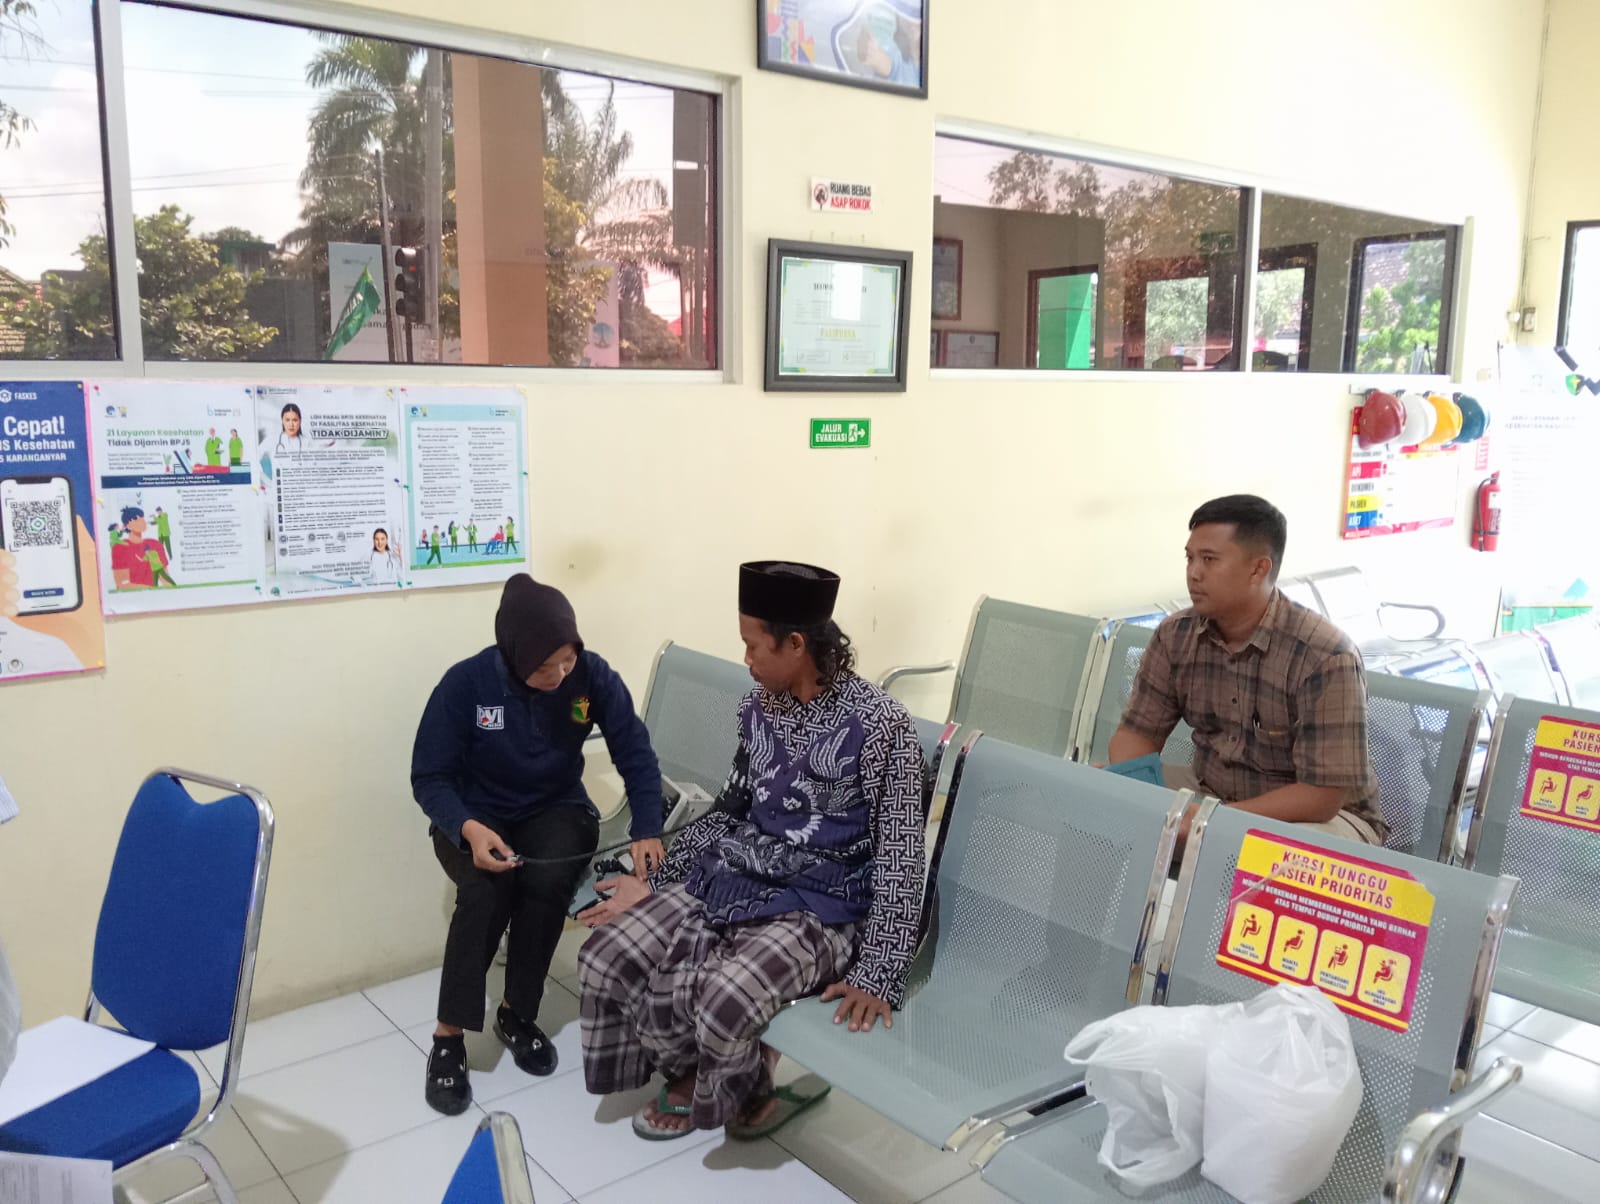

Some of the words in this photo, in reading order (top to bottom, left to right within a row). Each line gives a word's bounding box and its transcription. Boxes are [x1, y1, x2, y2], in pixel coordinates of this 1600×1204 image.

[830, 181, 850, 195] RUANG
[851, 184, 871, 197] BEBAS
[830, 196, 848, 209] ASAP
[849, 198, 871, 211] ROKOK
[14, 392, 38, 400] FASKES
[4, 415, 65, 440] Cepat!
[116, 429, 156, 438] Layanan
[157, 428, 204, 436] Kesehatan
[312, 430, 341, 438] TIDAK
[342, 429, 387, 438] DIJAMIN?
[821, 424, 842, 432] JALUR
[134, 439, 169, 448] Dijamin
[815, 433, 847, 442] EVAKUASI
[14, 438, 75, 451] Kesehatan
[6, 453, 67, 463] KARANGANYAR
[1283, 851, 1324, 872] KURSI
[1330, 864, 1388, 891] TUNGGU
[1272, 863, 1316, 886] PASIEN
[1320, 878, 1393, 908] PRIORITAS
[1265, 885, 1297, 900] BERKENAN
[1299, 894, 1342, 915] MEMBERIKAN
[1342, 907, 1368, 924] KEPADA
[1370, 915, 1387, 929] YANG
[1388, 921, 1417, 938] BERHAK
[1275, 898, 1290, 908] ATAS
[1291, 902, 1316, 916] TEMPAT
[1340, 917, 1376, 935] PRIORITAS
